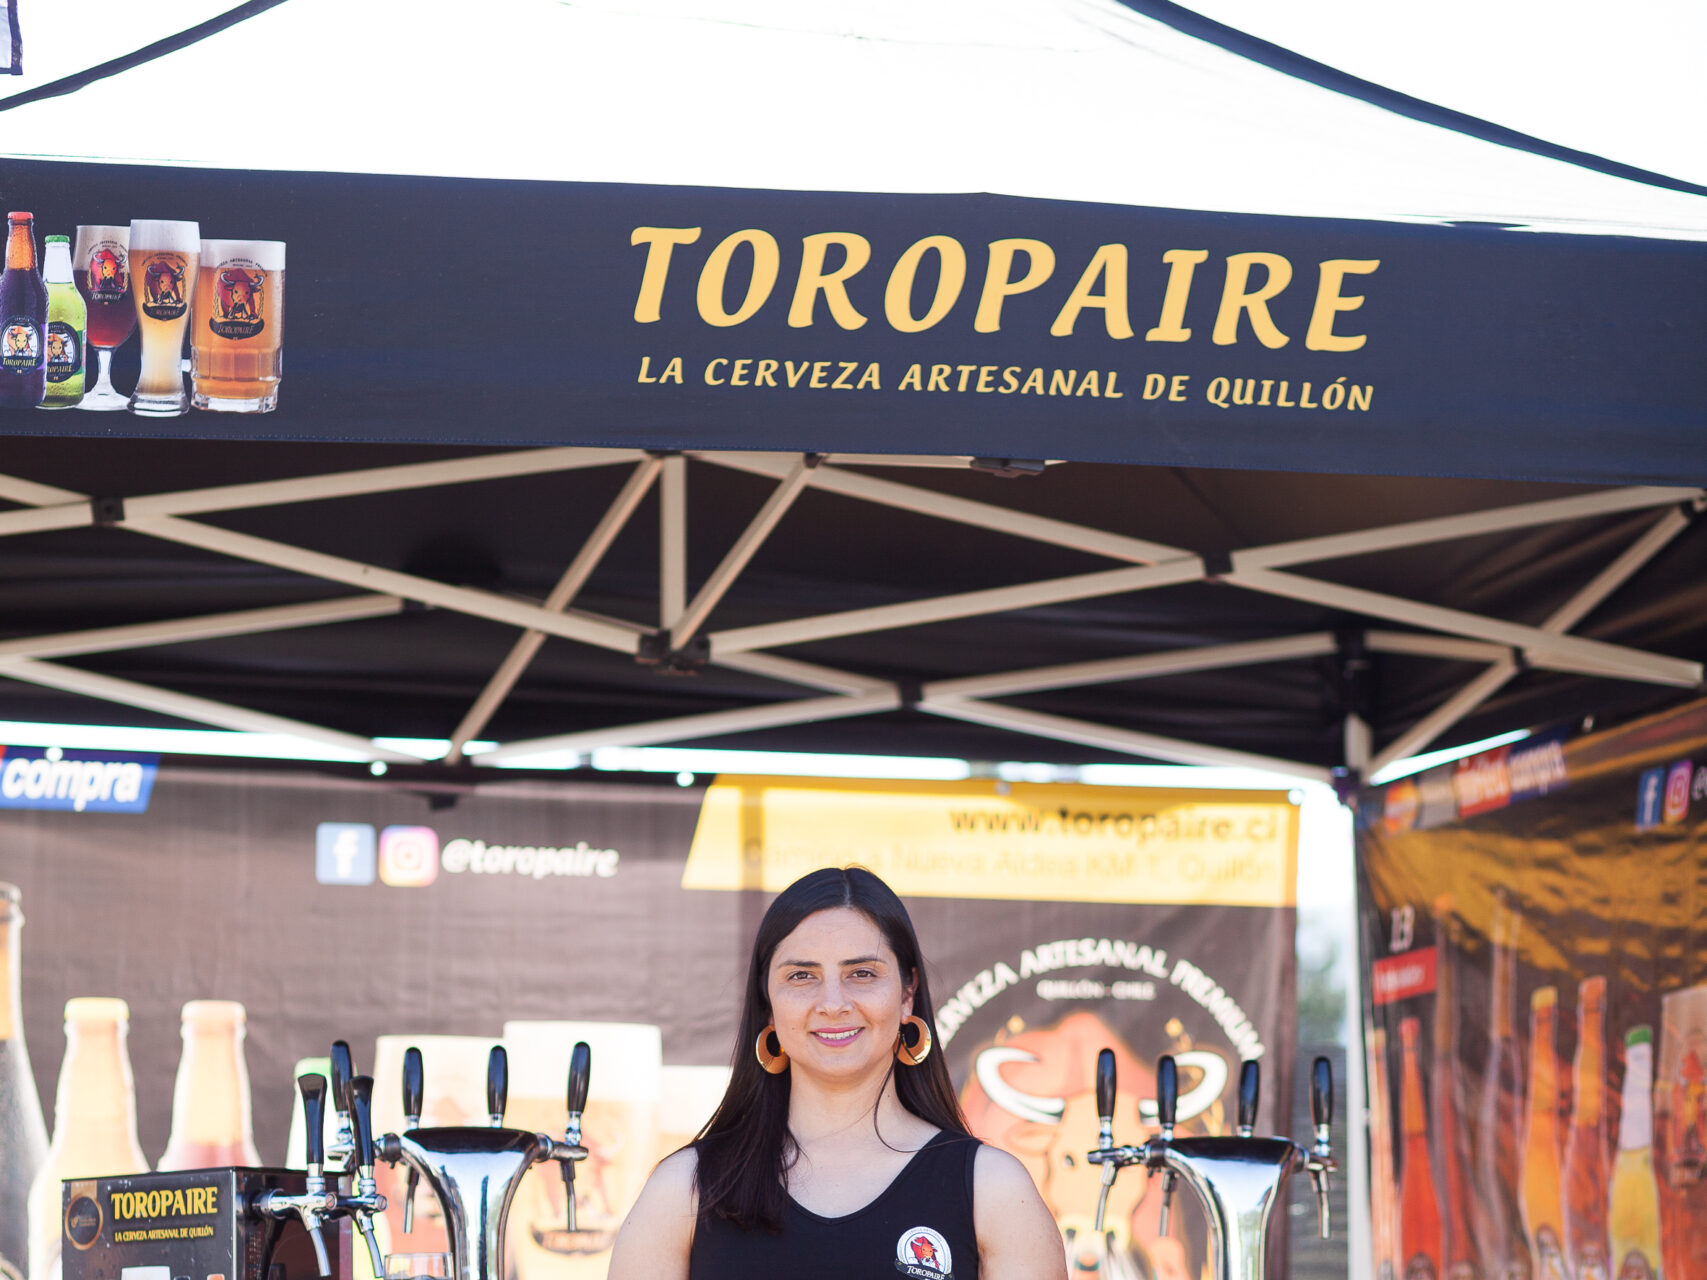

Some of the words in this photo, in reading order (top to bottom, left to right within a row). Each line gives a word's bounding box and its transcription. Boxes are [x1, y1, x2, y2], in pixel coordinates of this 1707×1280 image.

[630, 226, 1381, 352] TOROPAIRE
[637, 356, 685, 385] LA
[704, 358, 882, 391] CERVEZA
[898, 363, 1124, 398] ARTESANAL
[1142, 374, 1190, 402] DE
[1206, 377, 1374, 411] QUILLÓN
[2, 757, 143, 812] compra
[441, 837, 619, 880] @toropaire
[934, 962, 1019, 1050] ERVEZA
[1019, 937, 1170, 979] ARTESANAL
[111, 1186, 219, 1220] TOROPAIRE
[123, 1230, 147, 1242] CERVEZA
[148, 1228, 179, 1240] ARTESANAL
